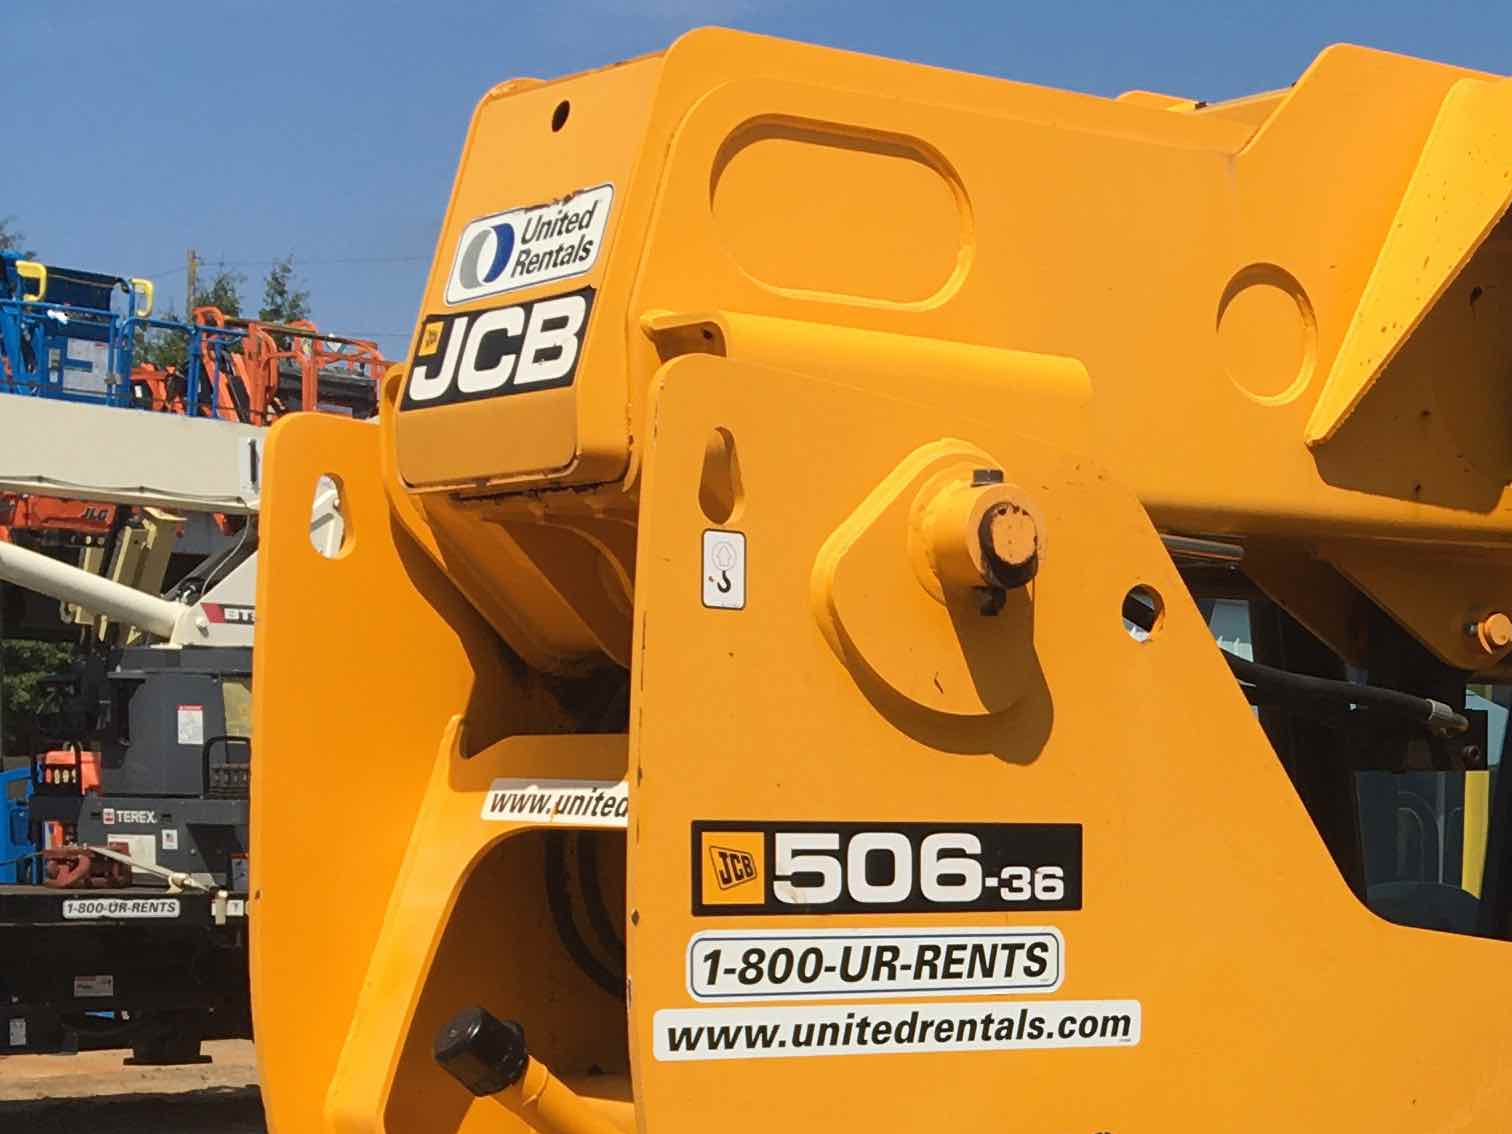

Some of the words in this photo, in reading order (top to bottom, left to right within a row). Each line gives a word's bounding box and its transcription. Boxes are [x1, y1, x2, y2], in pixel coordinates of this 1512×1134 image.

[521, 199, 600, 245] United
[510, 234, 595, 279] Rentals
[409, 295, 587, 401] JCB
[116, 810, 155, 823] TEREX
[717, 850, 755, 885] JCB
[772, 832, 1065, 905] 506-36
[67, 902, 177, 915] 1-800-UR-RENTS
[702, 941, 1050, 986] 1-800-UR-RENTS
[667, 1008, 1132, 1052] www.unitedrentals.com
